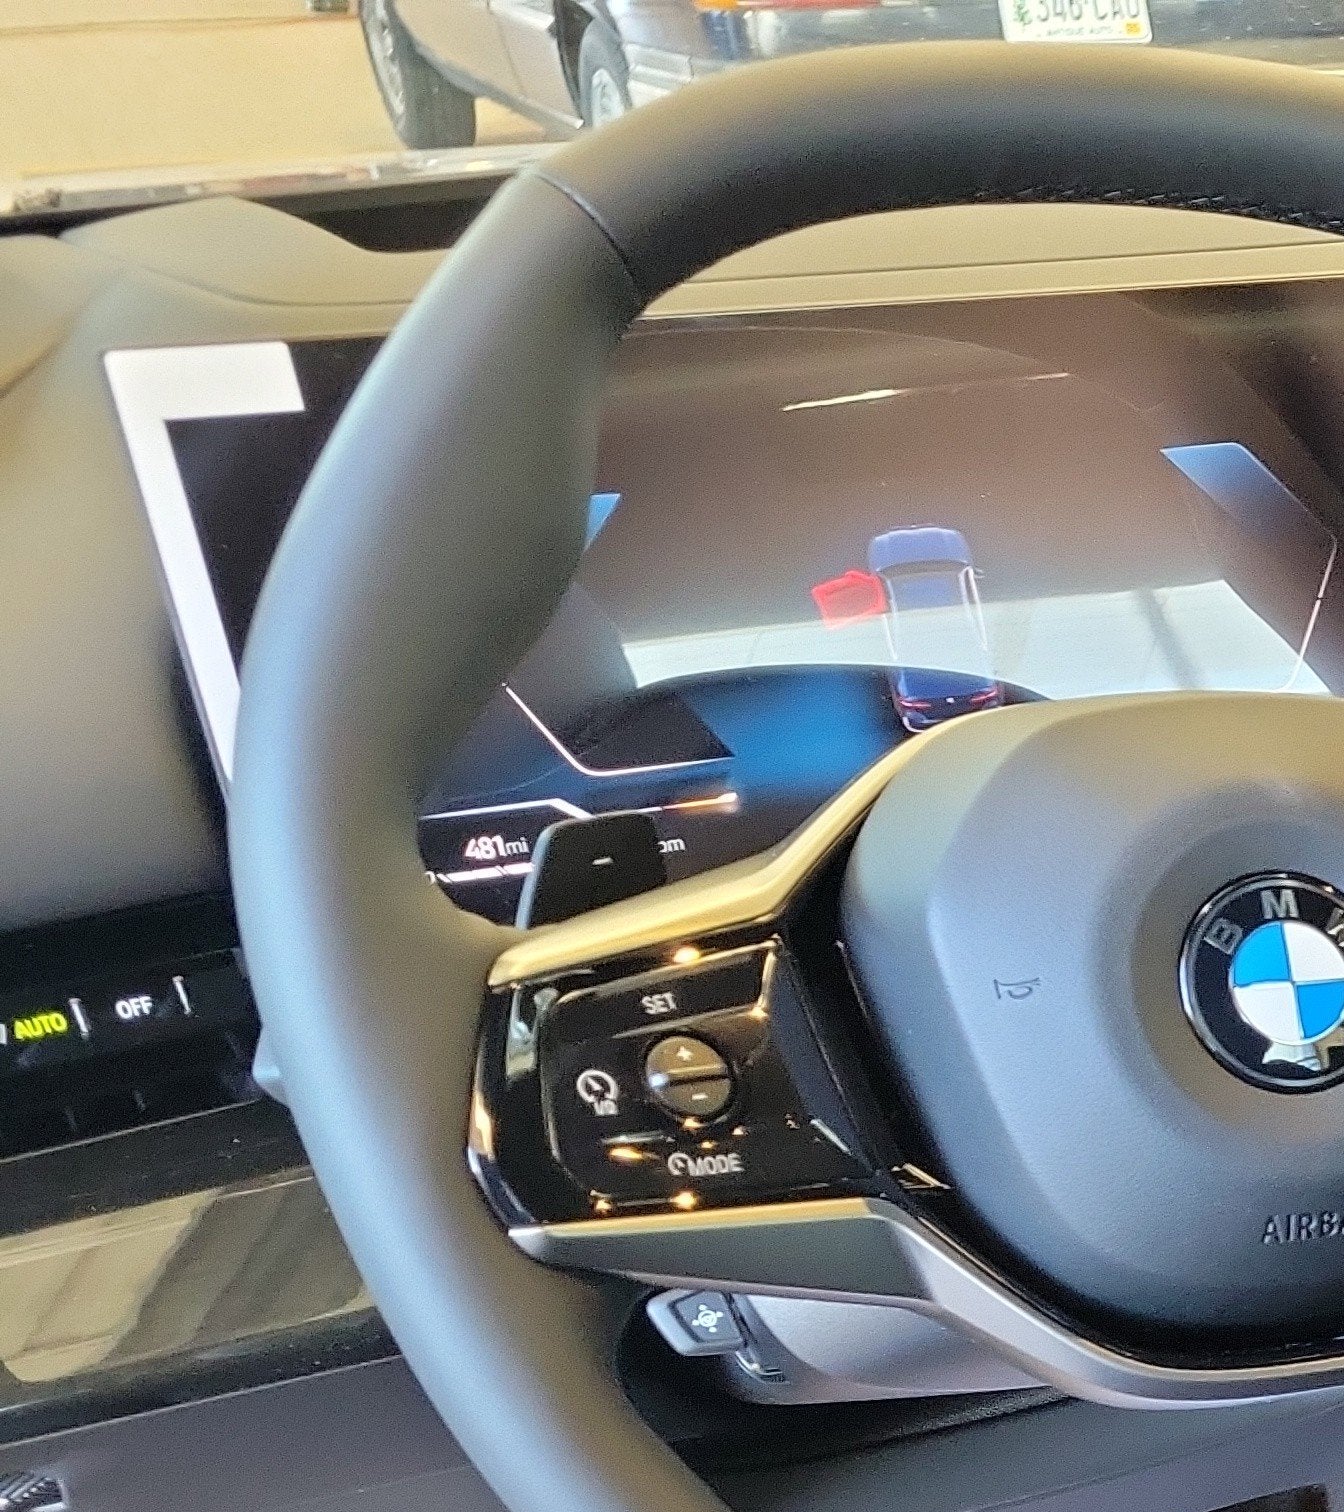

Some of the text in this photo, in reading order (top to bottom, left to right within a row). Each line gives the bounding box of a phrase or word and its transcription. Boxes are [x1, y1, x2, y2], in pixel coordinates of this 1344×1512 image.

[115, 996, 153, 1020] OFF
[641, 992, 677, 1015] SET
[14, 1012, 67, 1040] AUTO
[689, 1152, 745, 1177] MODE
